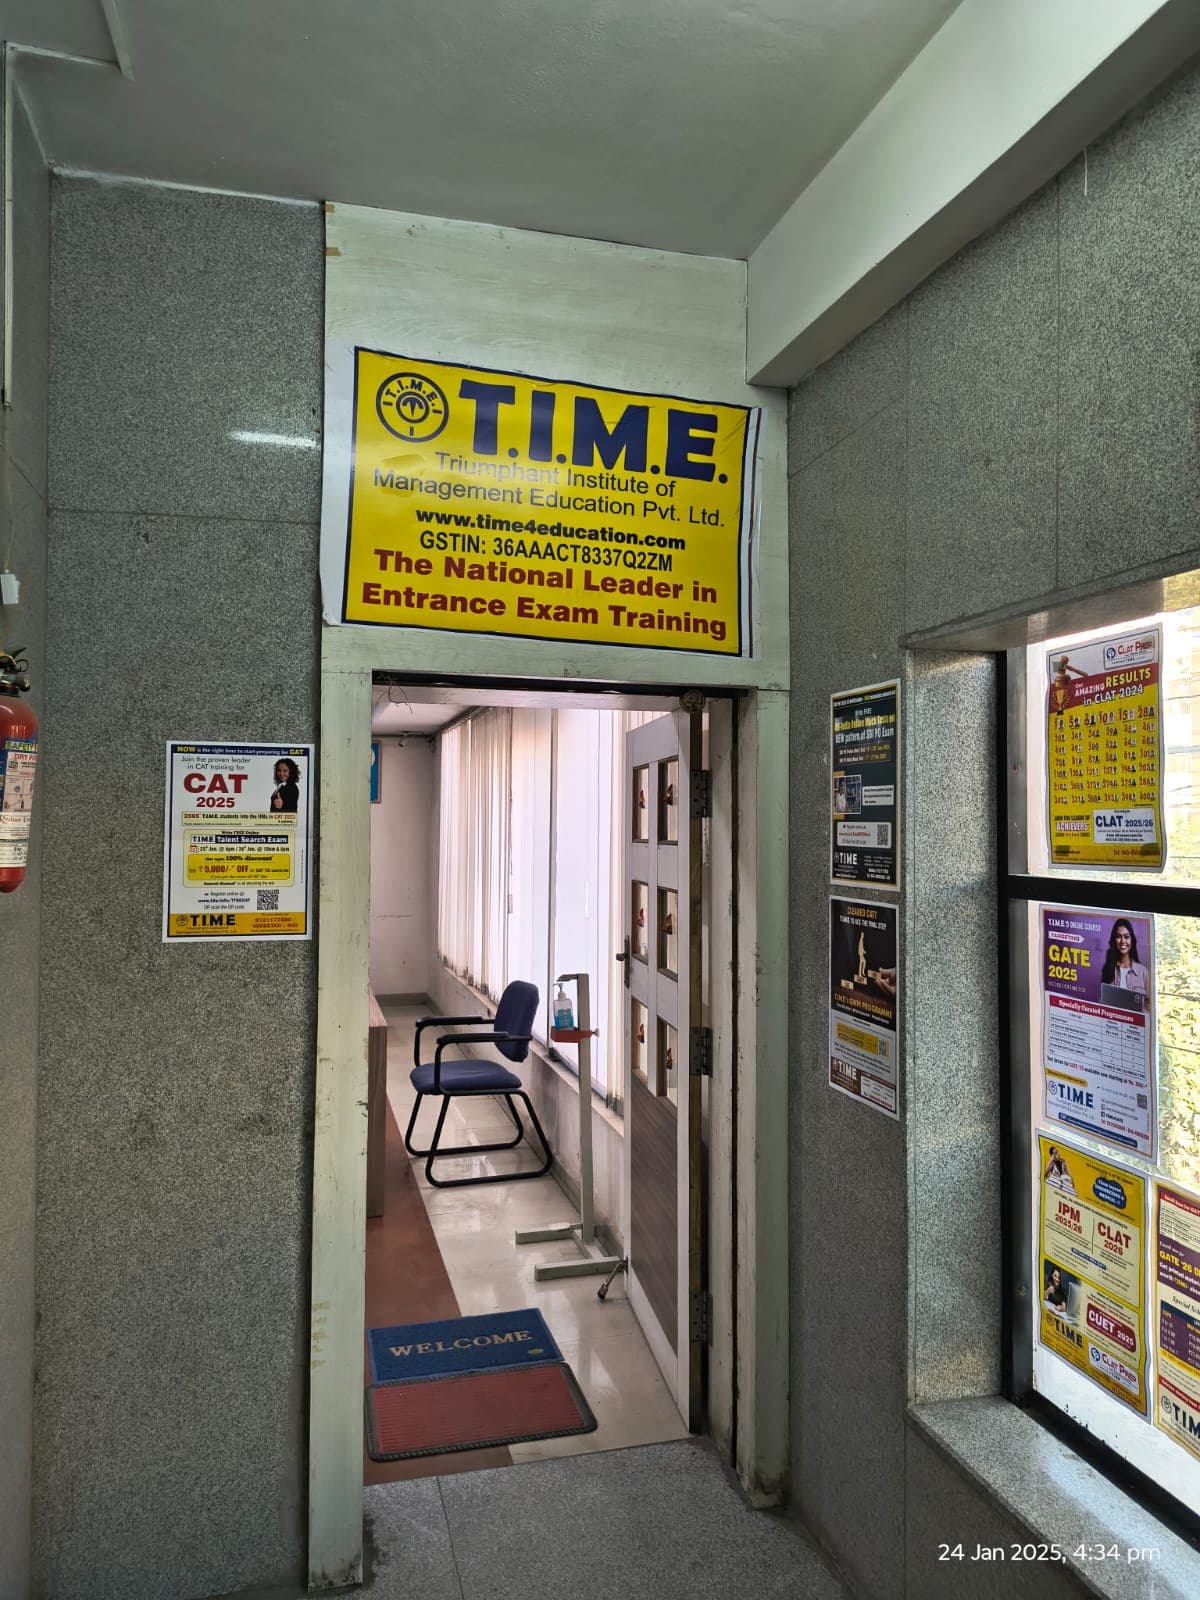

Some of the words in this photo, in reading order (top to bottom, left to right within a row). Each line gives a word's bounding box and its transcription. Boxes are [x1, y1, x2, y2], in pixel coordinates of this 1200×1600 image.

[459, 379, 728, 484] T.I.M.E.
[435, 451, 560, 484] Triumphant
[568, 470, 649, 495] Institute
[655, 478, 677, 498] of
[374, 467, 523, 505] Management
[530, 488, 636, 516] Education
[643, 500, 681, 522] Pvt.
[688, 508, 726, 528] Ltd.
[416, 509, 686, 551] www.time4education.com
[419, 530, 487, 556] GSTIN:
[493, 537, 673, 573] 36AAACT8337Q2ZM
[374, 549, 433, 576] The
[444, 556, 573, 590] National
[583, 569, 684, 600] Leader
[692, 580, 718, 604] in
[362, 582, 506, 617] Entrance
[517, 597, 599, 625] Exam
[608, 604, 727, 641] Training
[1075, 683, 1105, 697] AMAZING
[1105, 668, 1151, 688] RESULTS
[1083, 696, 1092, 706] in
[1094, 690, 1115, 704] CLAT
[1119, 684, 1144, 699] 2024
[183, 772, 248, 794] CAT
[196, 796, 236, 808] 2025
[1095, 815, 1124, 828] CLAT
[216, 835, 240, 844] Talent
[241, 835, 266, 843] Search
[267, 836, 288, 844] Exam
[1048, 944, 1091, 967] GATE
[1048, 965, 1078, 982] 2025
[1058, 1200, 1081, 1223] IPM
[1097, 1221, 1131, 1249] CLAT
[1160, 1250, 1180, 1267] GATE
[1088, 1309, 1115, 1334] CUET
[1117, 1330, 1135, 1346] 2025
[389, 1329, 534, 1357] WELCOME
